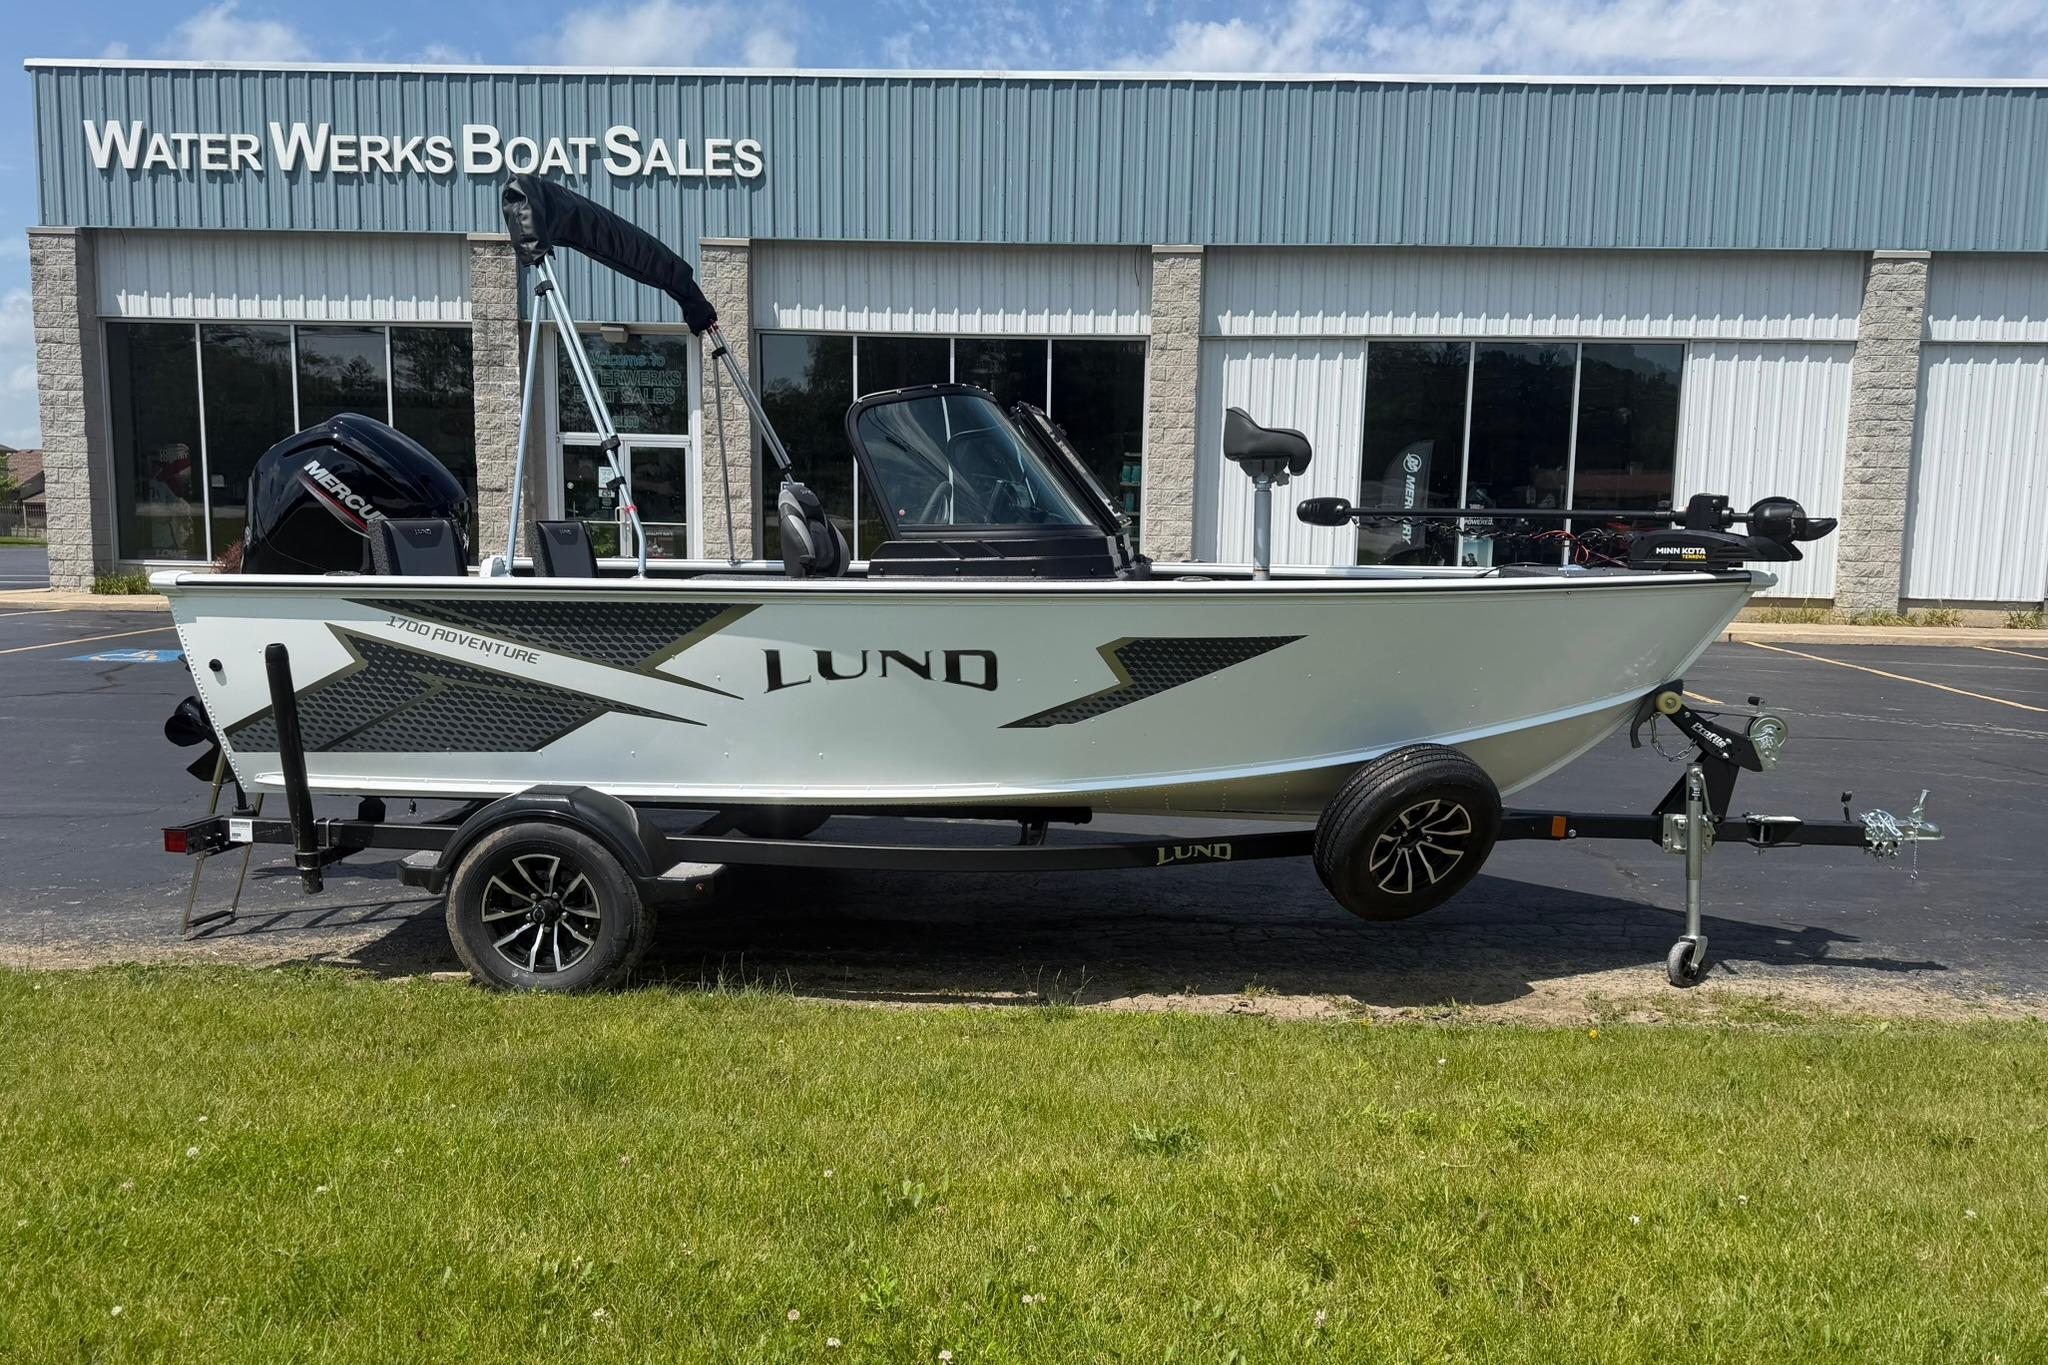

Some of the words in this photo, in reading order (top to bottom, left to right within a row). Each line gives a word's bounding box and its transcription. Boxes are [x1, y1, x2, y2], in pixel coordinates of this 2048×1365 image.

[83, 119, 264, 171] WATER
[269, 121, 454, 174] WERKS
[462, 123, 596, 175] BOAT
[603, 125, 764, 178] SALES
[649, 352, 666, 367] to
[566, 367, 682, 387] WTERWERKS
[573, 386, 617, 403] BAT
[621, 386, 676, 405] SALES
[303, 459, 389, 521] MERCU
[1401, 474, 1416, 545] MERRY
[1655, 547, 1680, 555] MINN
[1681, 547, 1706, 555] KOTA
[386, 615, 431, 637] 1700
[431, 627, 541, 665] ADVENTURE
[761, 648, 998, 694] LUND
[1156, 843, 1232, 866] LUND
